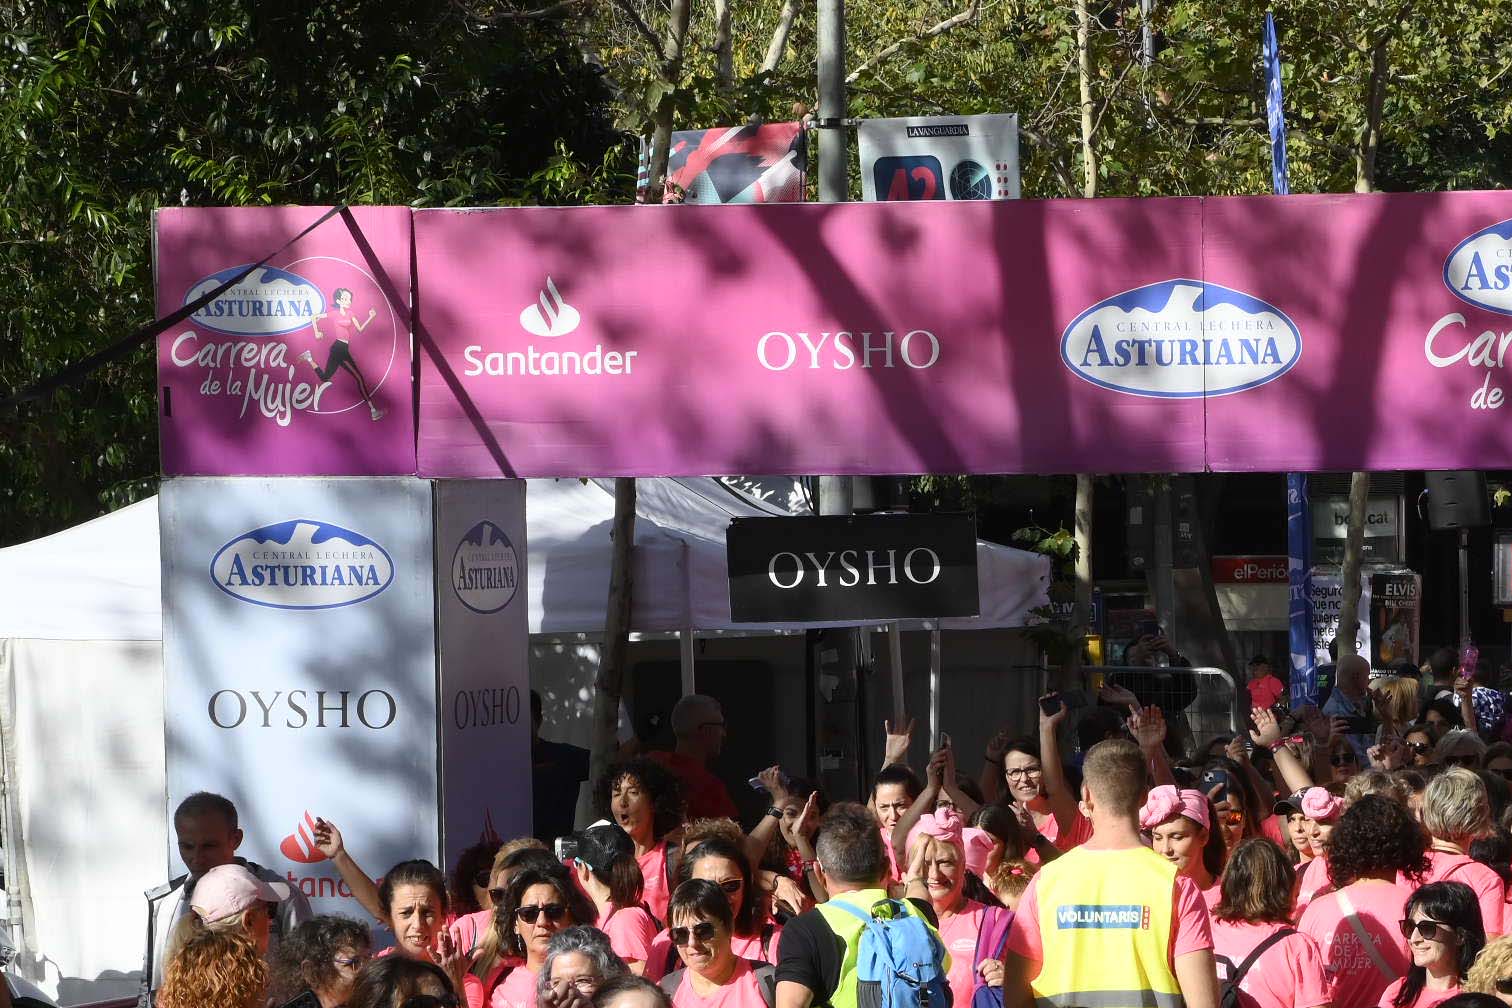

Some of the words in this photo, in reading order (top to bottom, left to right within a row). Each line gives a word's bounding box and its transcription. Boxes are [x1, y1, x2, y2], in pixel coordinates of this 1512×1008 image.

[192, 289, 314, 317] ASTURIANA
[220, 288, 261, 297] ENTRAL
[1116, 319, 1190, 333] CENTRAL
[1202, 319, 1276, 332] LECHERA
[171, 331, 287, 370] Carrera
[464, 345, 637, 376] Santander
[756, 329, 941, 372] OYSHO
[1079, 324, 1284, 368] ASTURIANA
[200, 373, 222, 396] de
[226, 373, 242, 396] la
[240, 362, 332, 427] Mujer
[1470, 371, 1503, 411] de
[226, 552, 381, 587] ASTURIANA
[253, 550, 311, 560] CENTRAL
[316, 550, 375, 560] LECHERA
[768, 548, 941, 589] OYSHO
[458, 556, 515, 591] ASTURIANA
[1386, 583, 1416, 596] ELVIS
[207, 689, 397, 730] OYSHO
[455, 685, 520, 731] OYSHO
[1057, 911, 1139, 924] VOLUNTARIS
